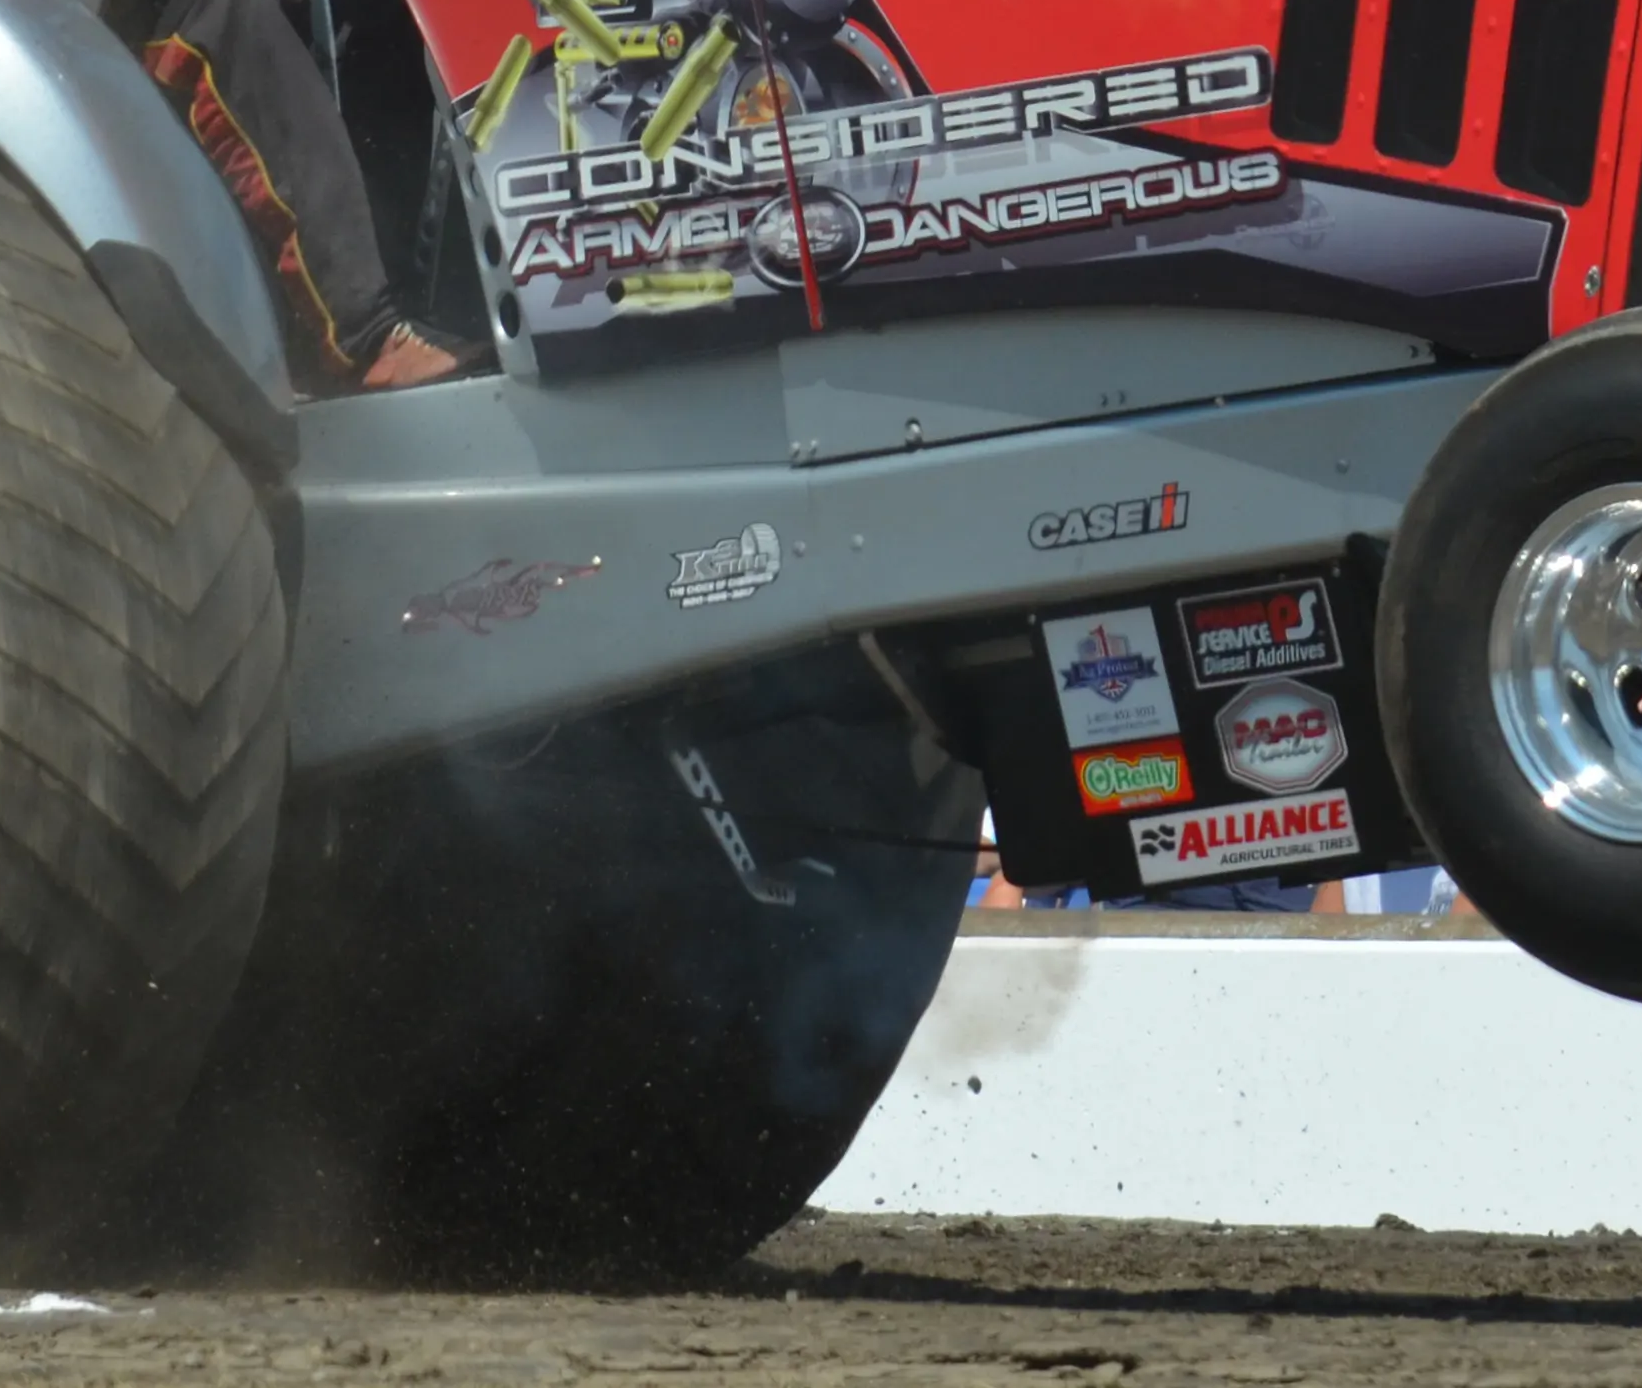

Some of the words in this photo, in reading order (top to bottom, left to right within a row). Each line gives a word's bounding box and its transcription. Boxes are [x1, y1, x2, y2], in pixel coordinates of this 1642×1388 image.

[496, 54, 1262, 209] CONSIDERED
[861, 153, 1281, 252] DANGEROUS
[1197, 622, 1273, 654] SERVICE
[1203, 651, 1250, 675] Diesel
[1256, 642, 1326, 668] Additives
[1087, 757, 1176, 797] O'Reilly
[1178, 799, 1348, 861] ALLIANCE
[1220, 844, 1315, 866] AGRICULTURAL
[1318, 836, 1354, 852] TIRES
